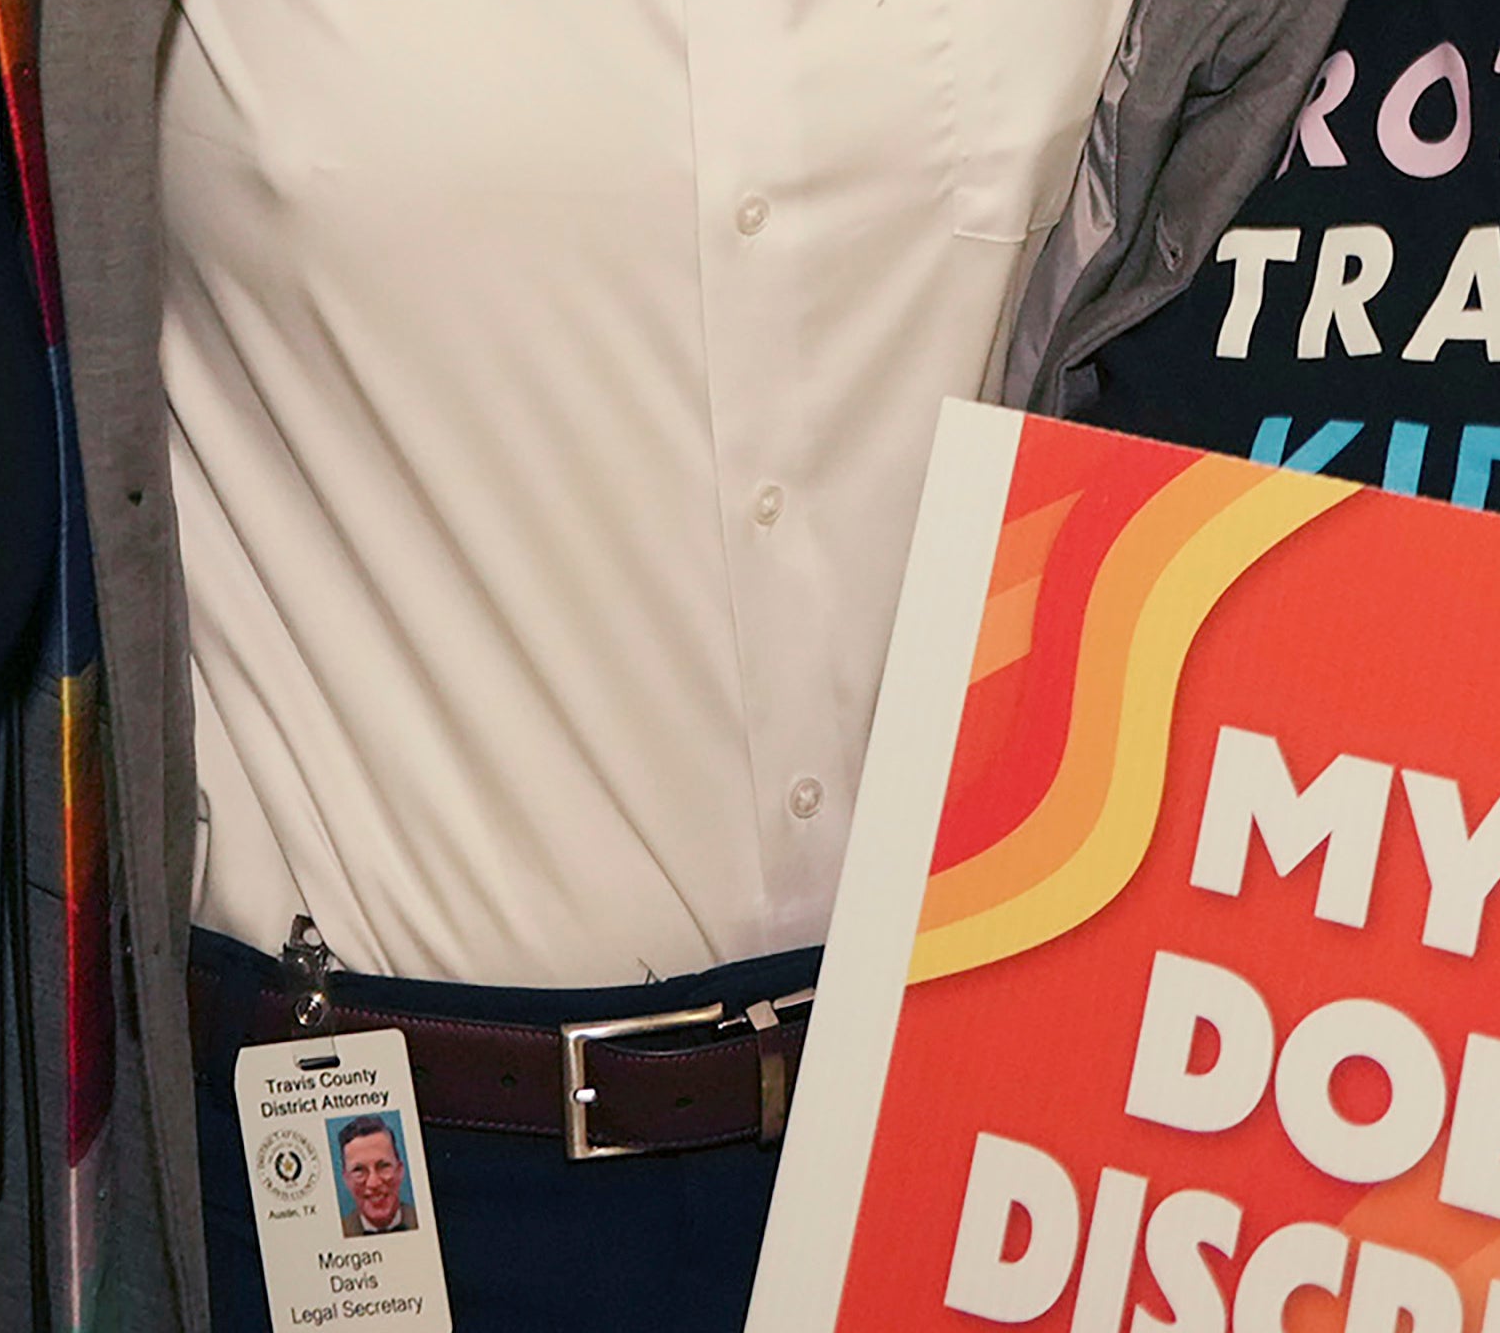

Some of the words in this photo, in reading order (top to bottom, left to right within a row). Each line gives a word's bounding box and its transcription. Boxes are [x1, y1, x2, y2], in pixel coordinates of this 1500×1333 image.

[265, 1075, 316, 1095] Travis
[320, 1068, 377, 1087] County
[260, 1097, 317, 1118] District
[322, 1090, 389, 1112] Attorney
[303, 1205, 316, 1215] TX
[318, 1248, 383, 1270] Morgan
[330, 1272, 379, 1294] Davis
[291, 1303, 337, 1327] Legal
[342, 1295, 423, 1319] Secretary
